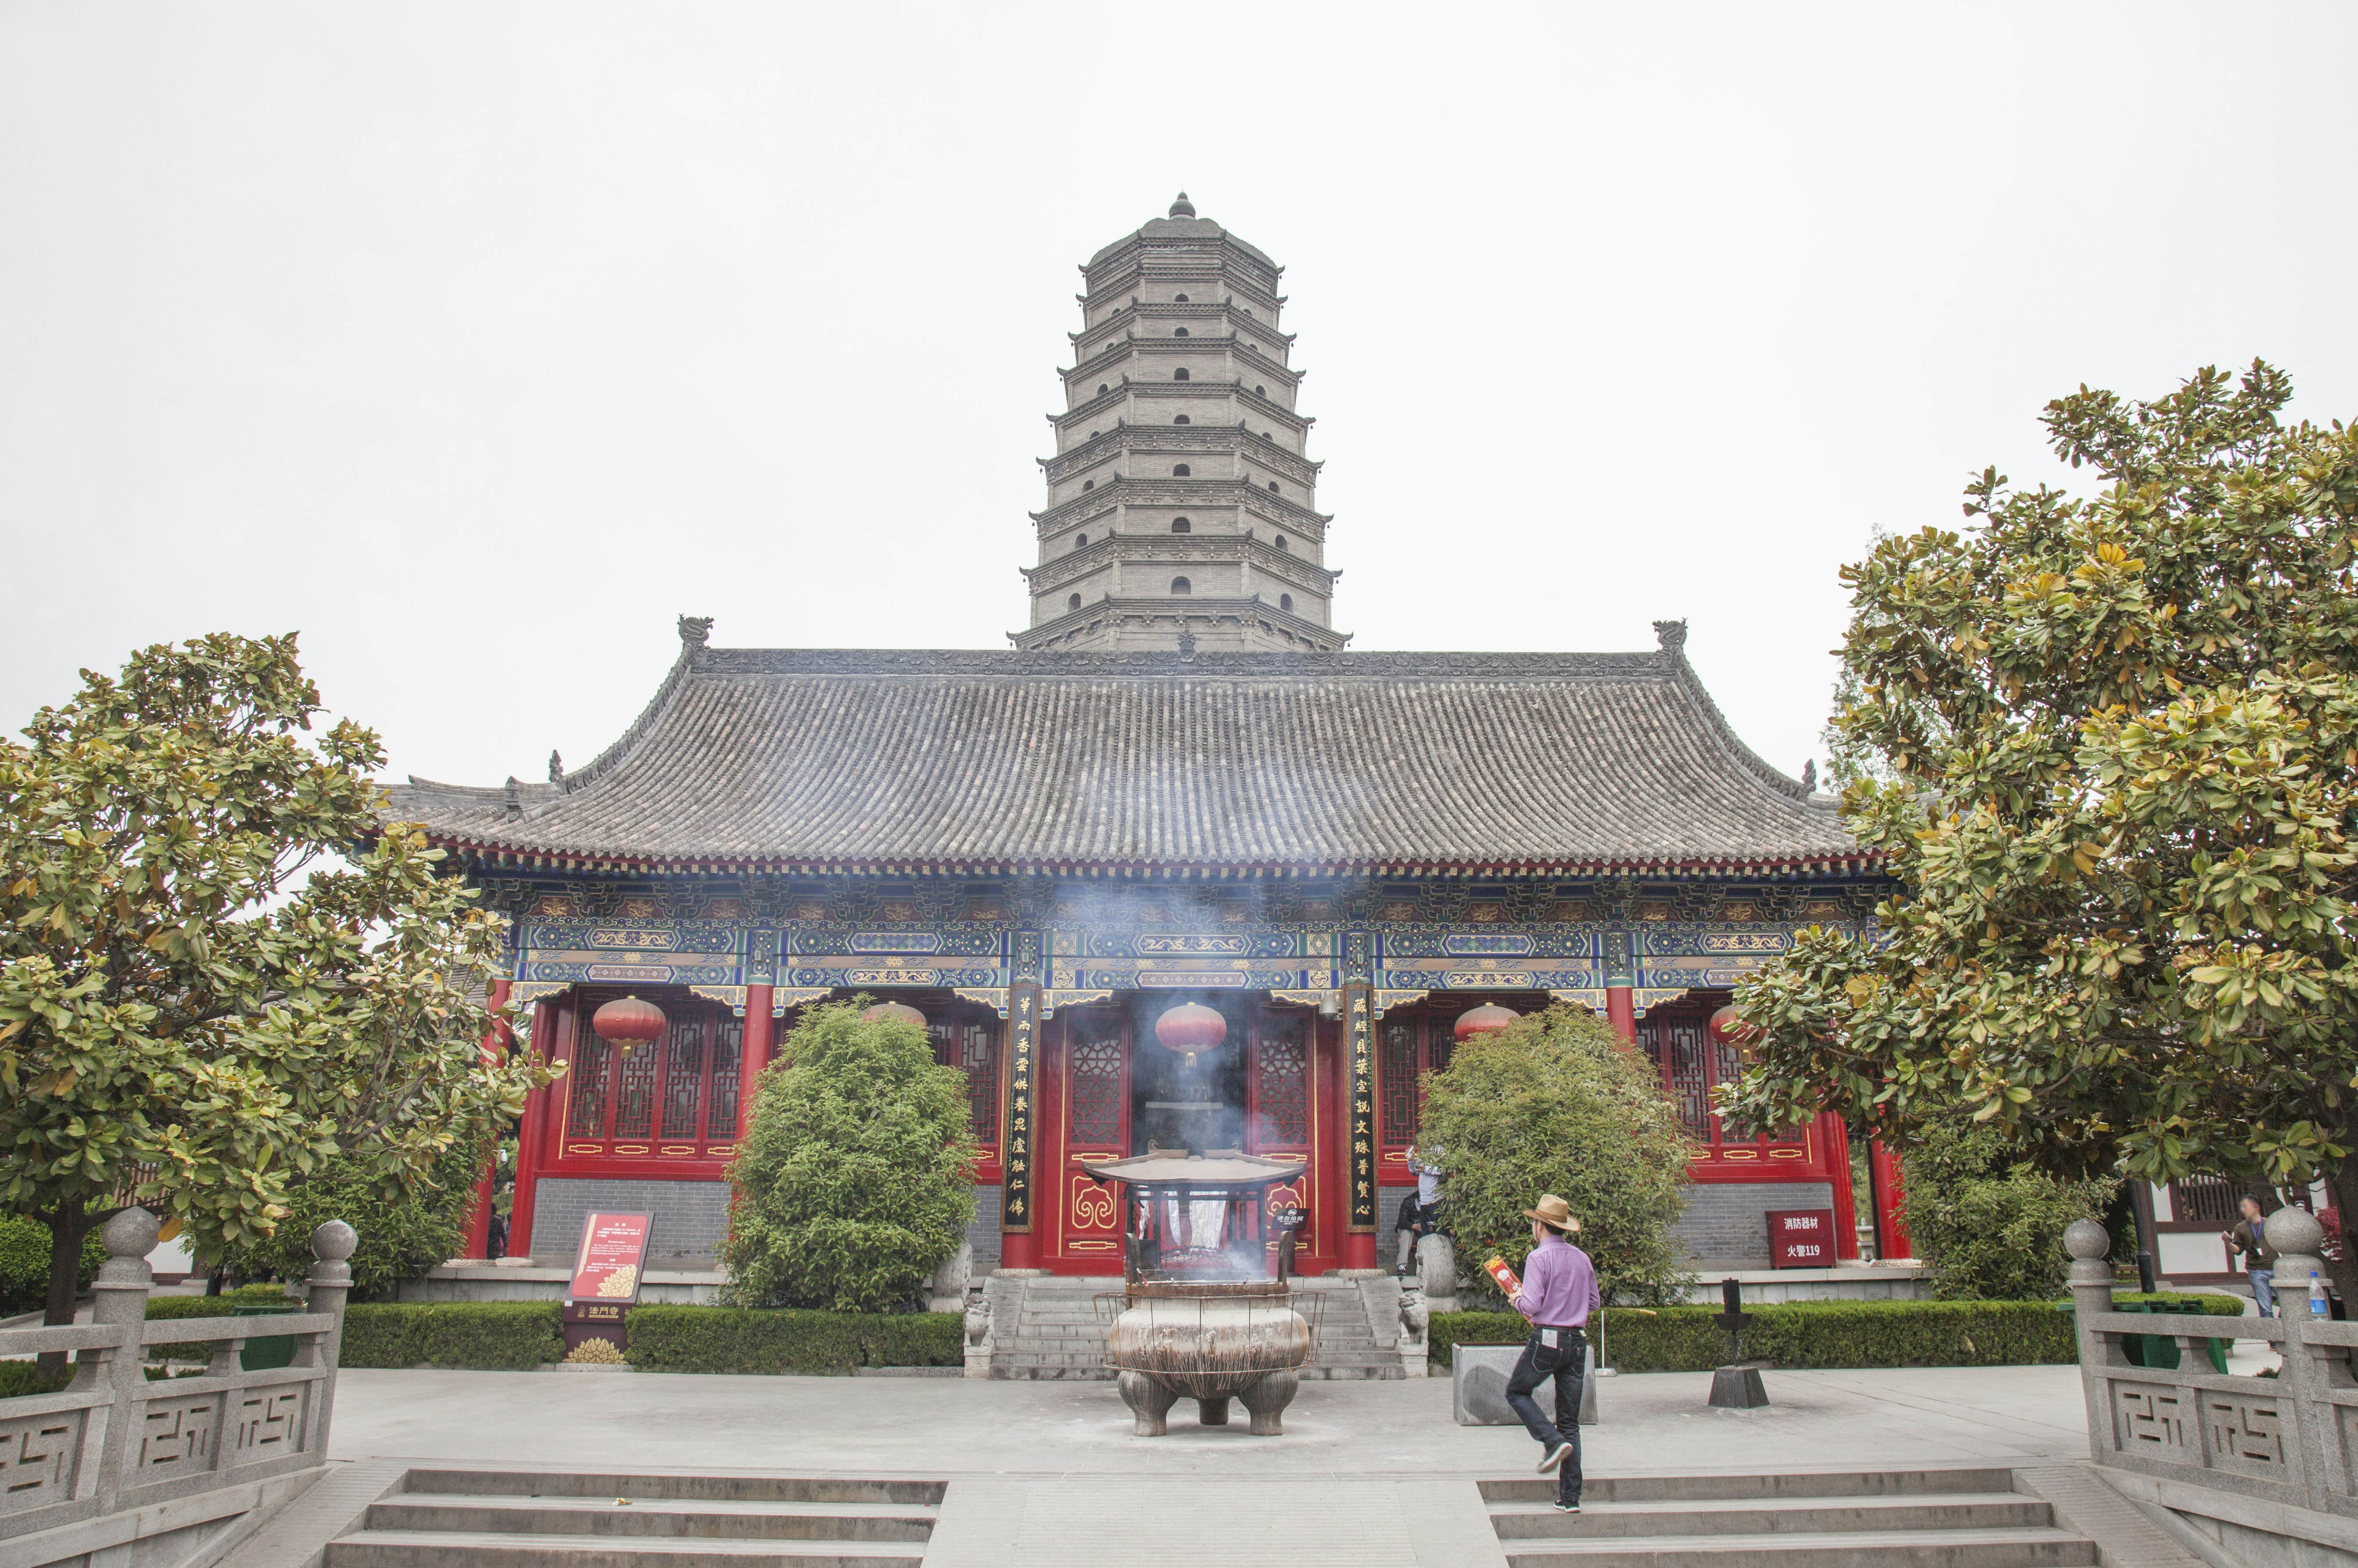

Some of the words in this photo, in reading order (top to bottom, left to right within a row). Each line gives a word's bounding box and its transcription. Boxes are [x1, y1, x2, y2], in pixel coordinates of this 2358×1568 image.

[1785, 1217, 1818, 1230] 消防器材
[1788, 1245, 1820, 1257] 火警119
[589, 1306, 619, 1315] 法門寺
